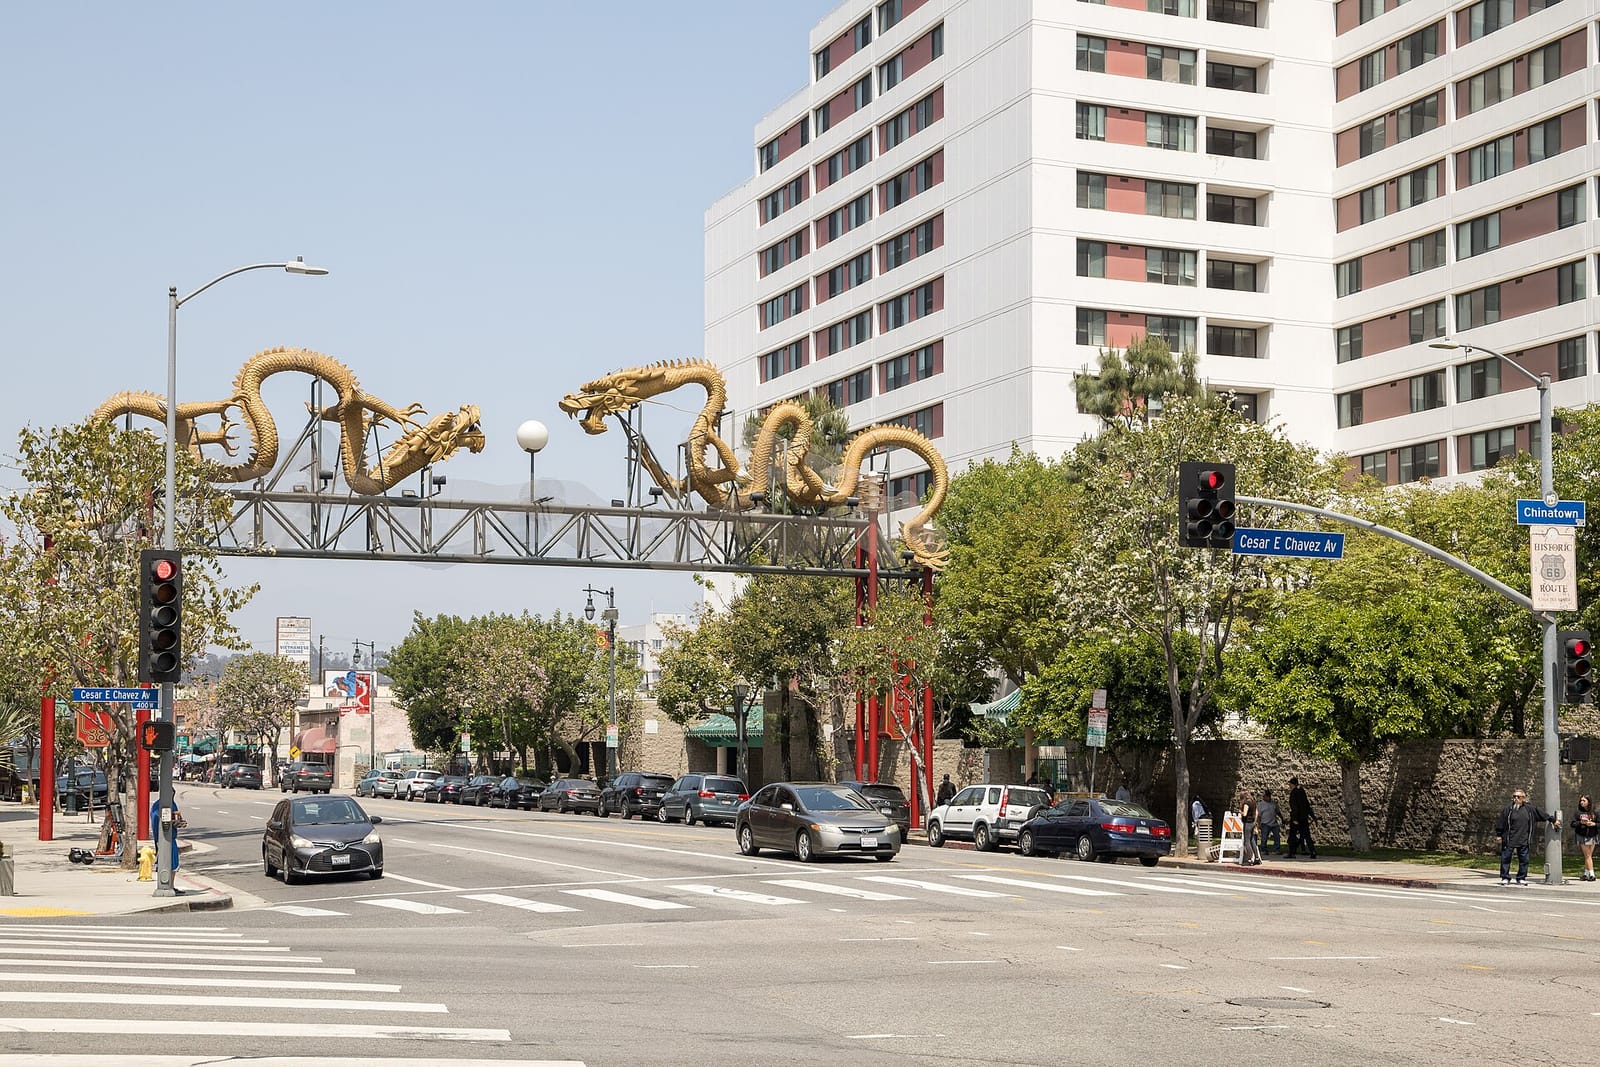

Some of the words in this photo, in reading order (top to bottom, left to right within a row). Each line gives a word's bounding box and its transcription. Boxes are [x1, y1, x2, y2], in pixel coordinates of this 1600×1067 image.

[1523, 507, 1578, 518] Chinatown
[1240, 534, 1270, 549] Cesar
[1273, 536, 1281, 550] E
[1285, 537, 1321, 552] Chavez
[1324, 539, 1337, 552] Av
[1534, 543, 1572, 551] HISTORIC
[1546, 568, 1560, 577] 66
[1540, 584, 1568, 592] ROUTE
[80, 690, 102, 699] Cesar
[105, 690, 111, 699] E
[112, 690, 139, 700] Chavez
[141, 690, 151, 700] Av
